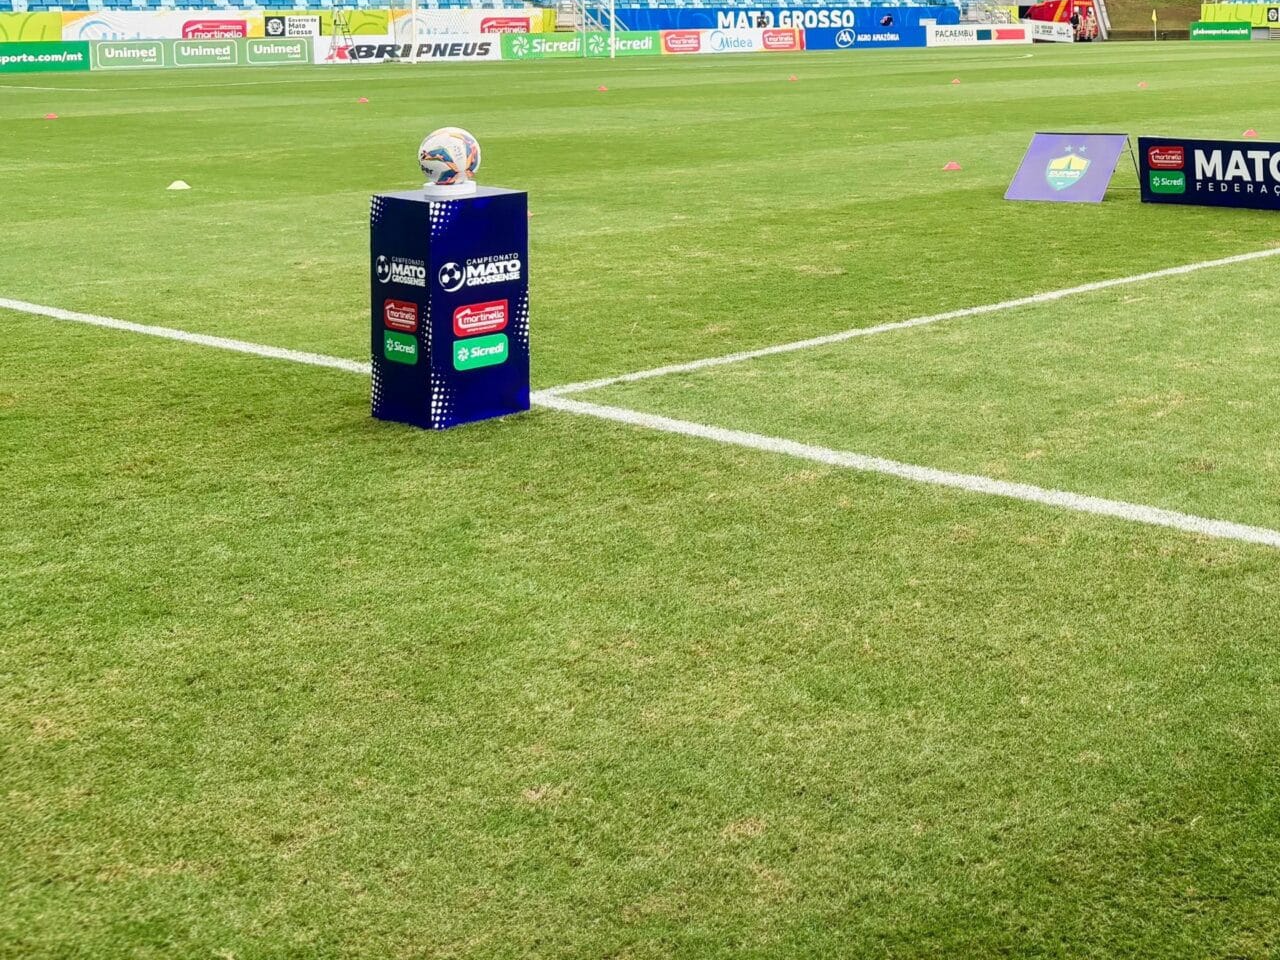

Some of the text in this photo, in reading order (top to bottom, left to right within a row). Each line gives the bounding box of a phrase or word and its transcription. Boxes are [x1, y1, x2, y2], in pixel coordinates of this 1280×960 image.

[717, 10, 855, 29] MATO GROSSO
[935, 29, 974, 38] PACAEMBU
[181, 46, 230, 56] Unimed
[253, 44, 300, 54] Unimed
[416, 42, 492, 58] PNEUS
[531, 38, 581, 52] Sicredi
[105, 47, 157, 58] Unimed
[1160, 177, 1184, 186] Sicredi
[466, 253, 519, 266] CAMPEONATO
[392, 263, 426, 279] MATO
[467, 259, 521, 279] MATO
[466, 272, 521, 286] GROSSENSE
[390, 310, 415, 321] martinello
[463, 310, 504, 324] martinello
[394, 343, 415, 354] Sicredi
[471, 342, 504, 358] Sicredi
